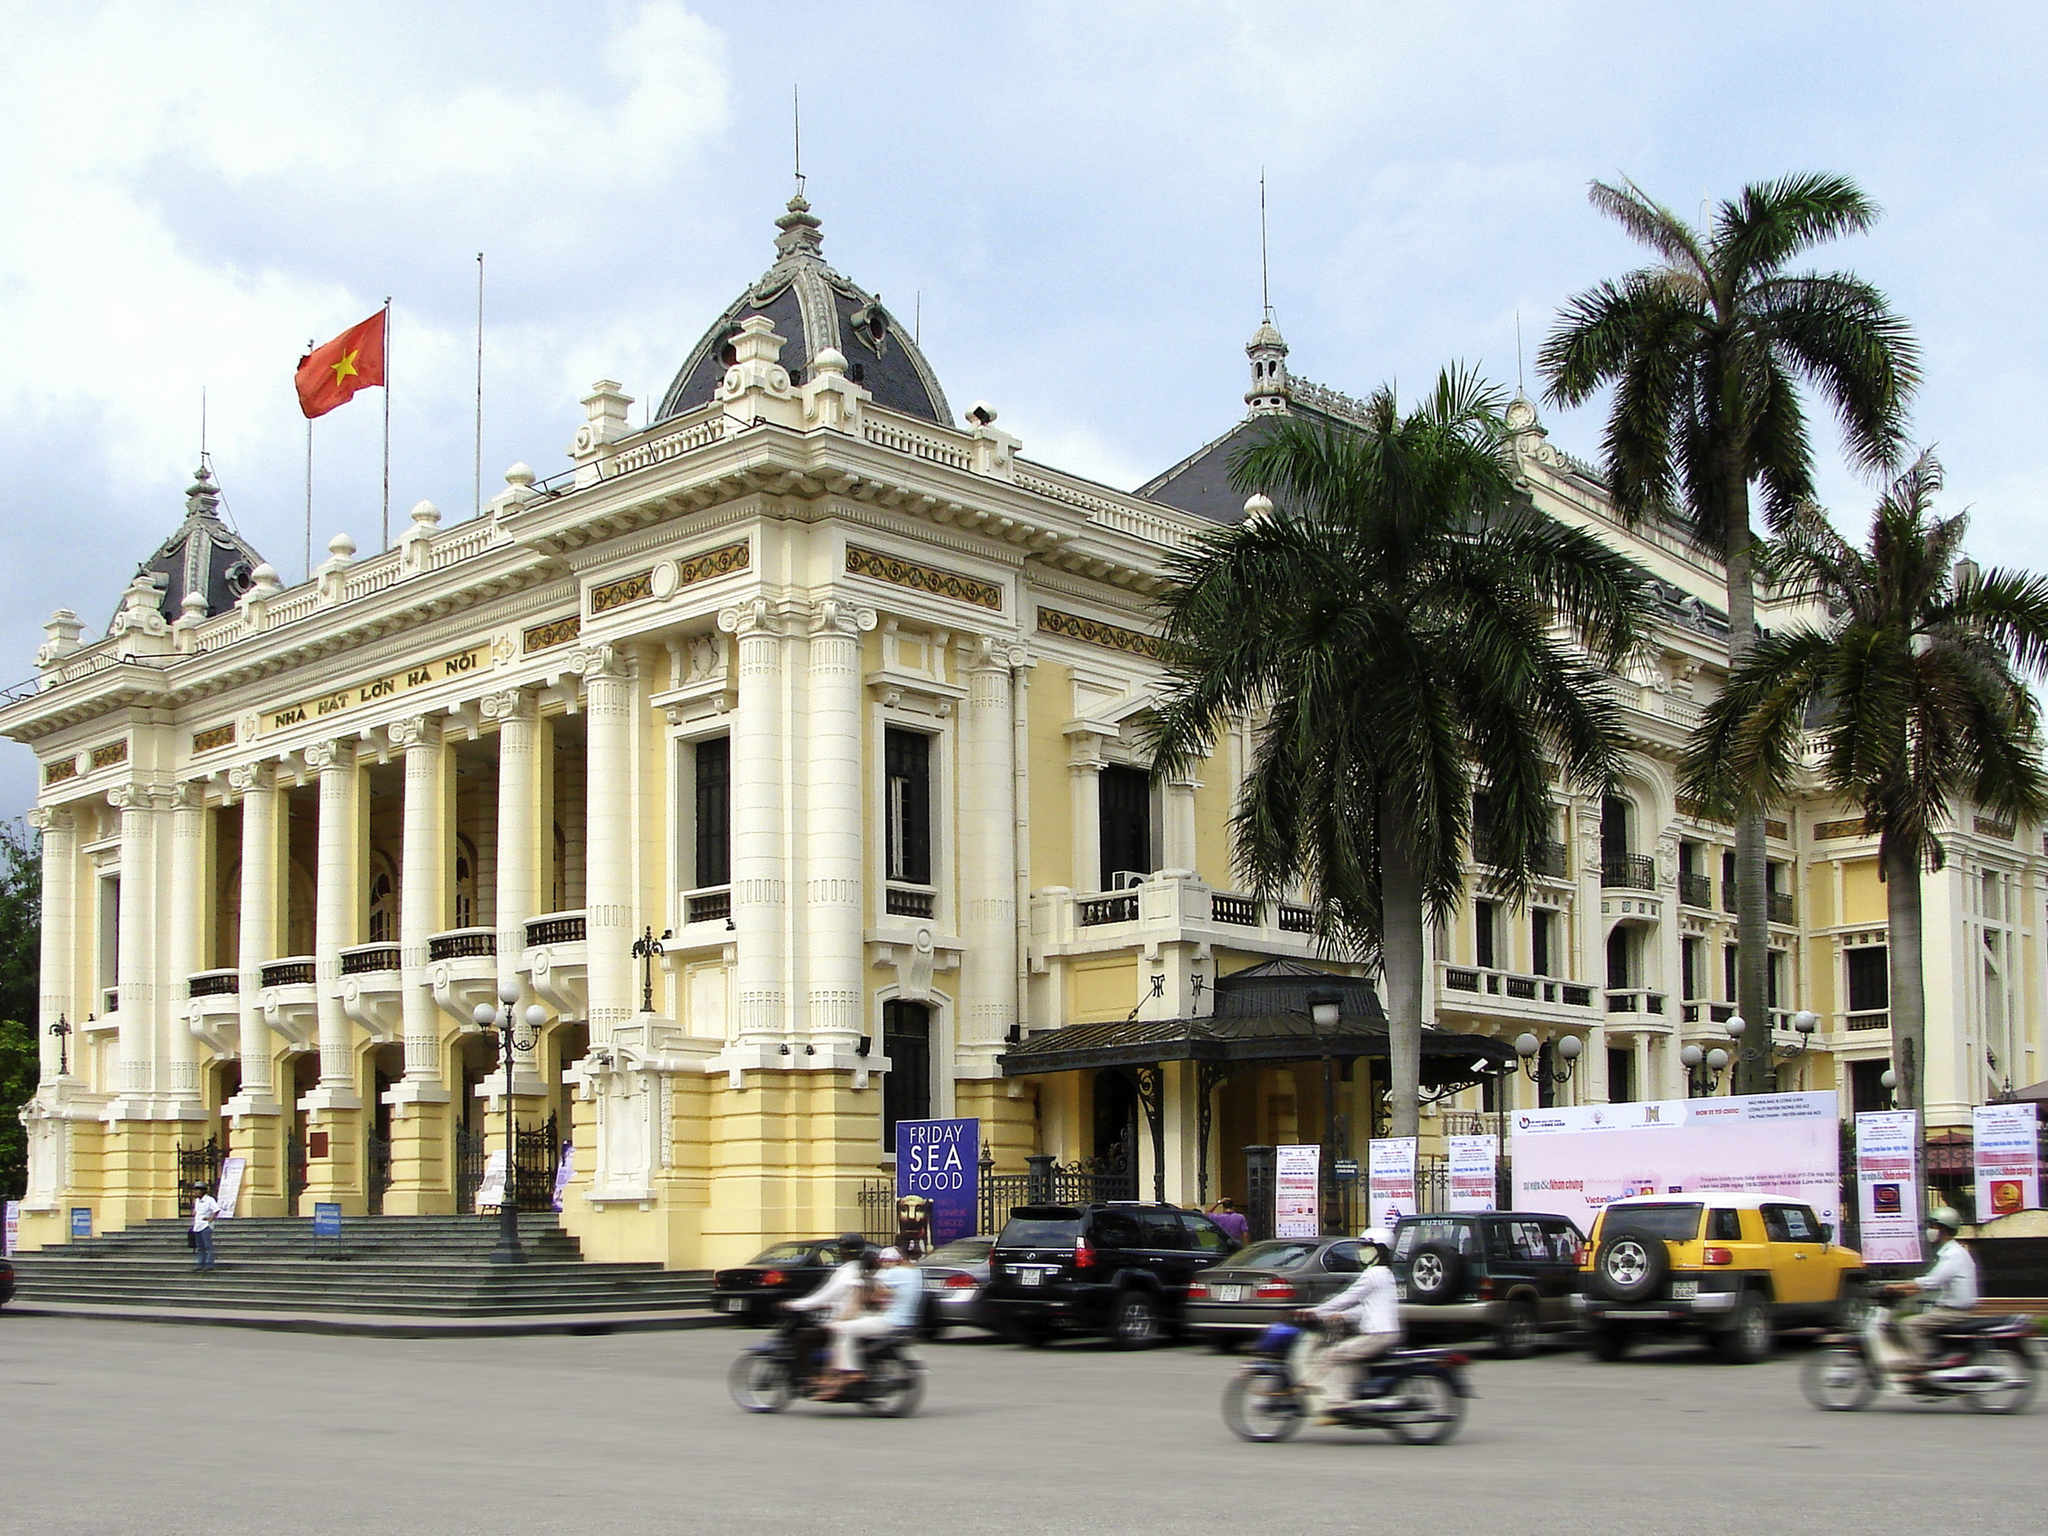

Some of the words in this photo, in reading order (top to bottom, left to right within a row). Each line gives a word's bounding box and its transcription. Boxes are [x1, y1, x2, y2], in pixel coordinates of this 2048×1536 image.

[909, 1124, 963, 1144] FRIDAY
[909, 1143, 963, 1172] SEA
[908, 1171, 963, 1191] FOOD
[1419, 1219, 1454, 1227] SUZUKI
